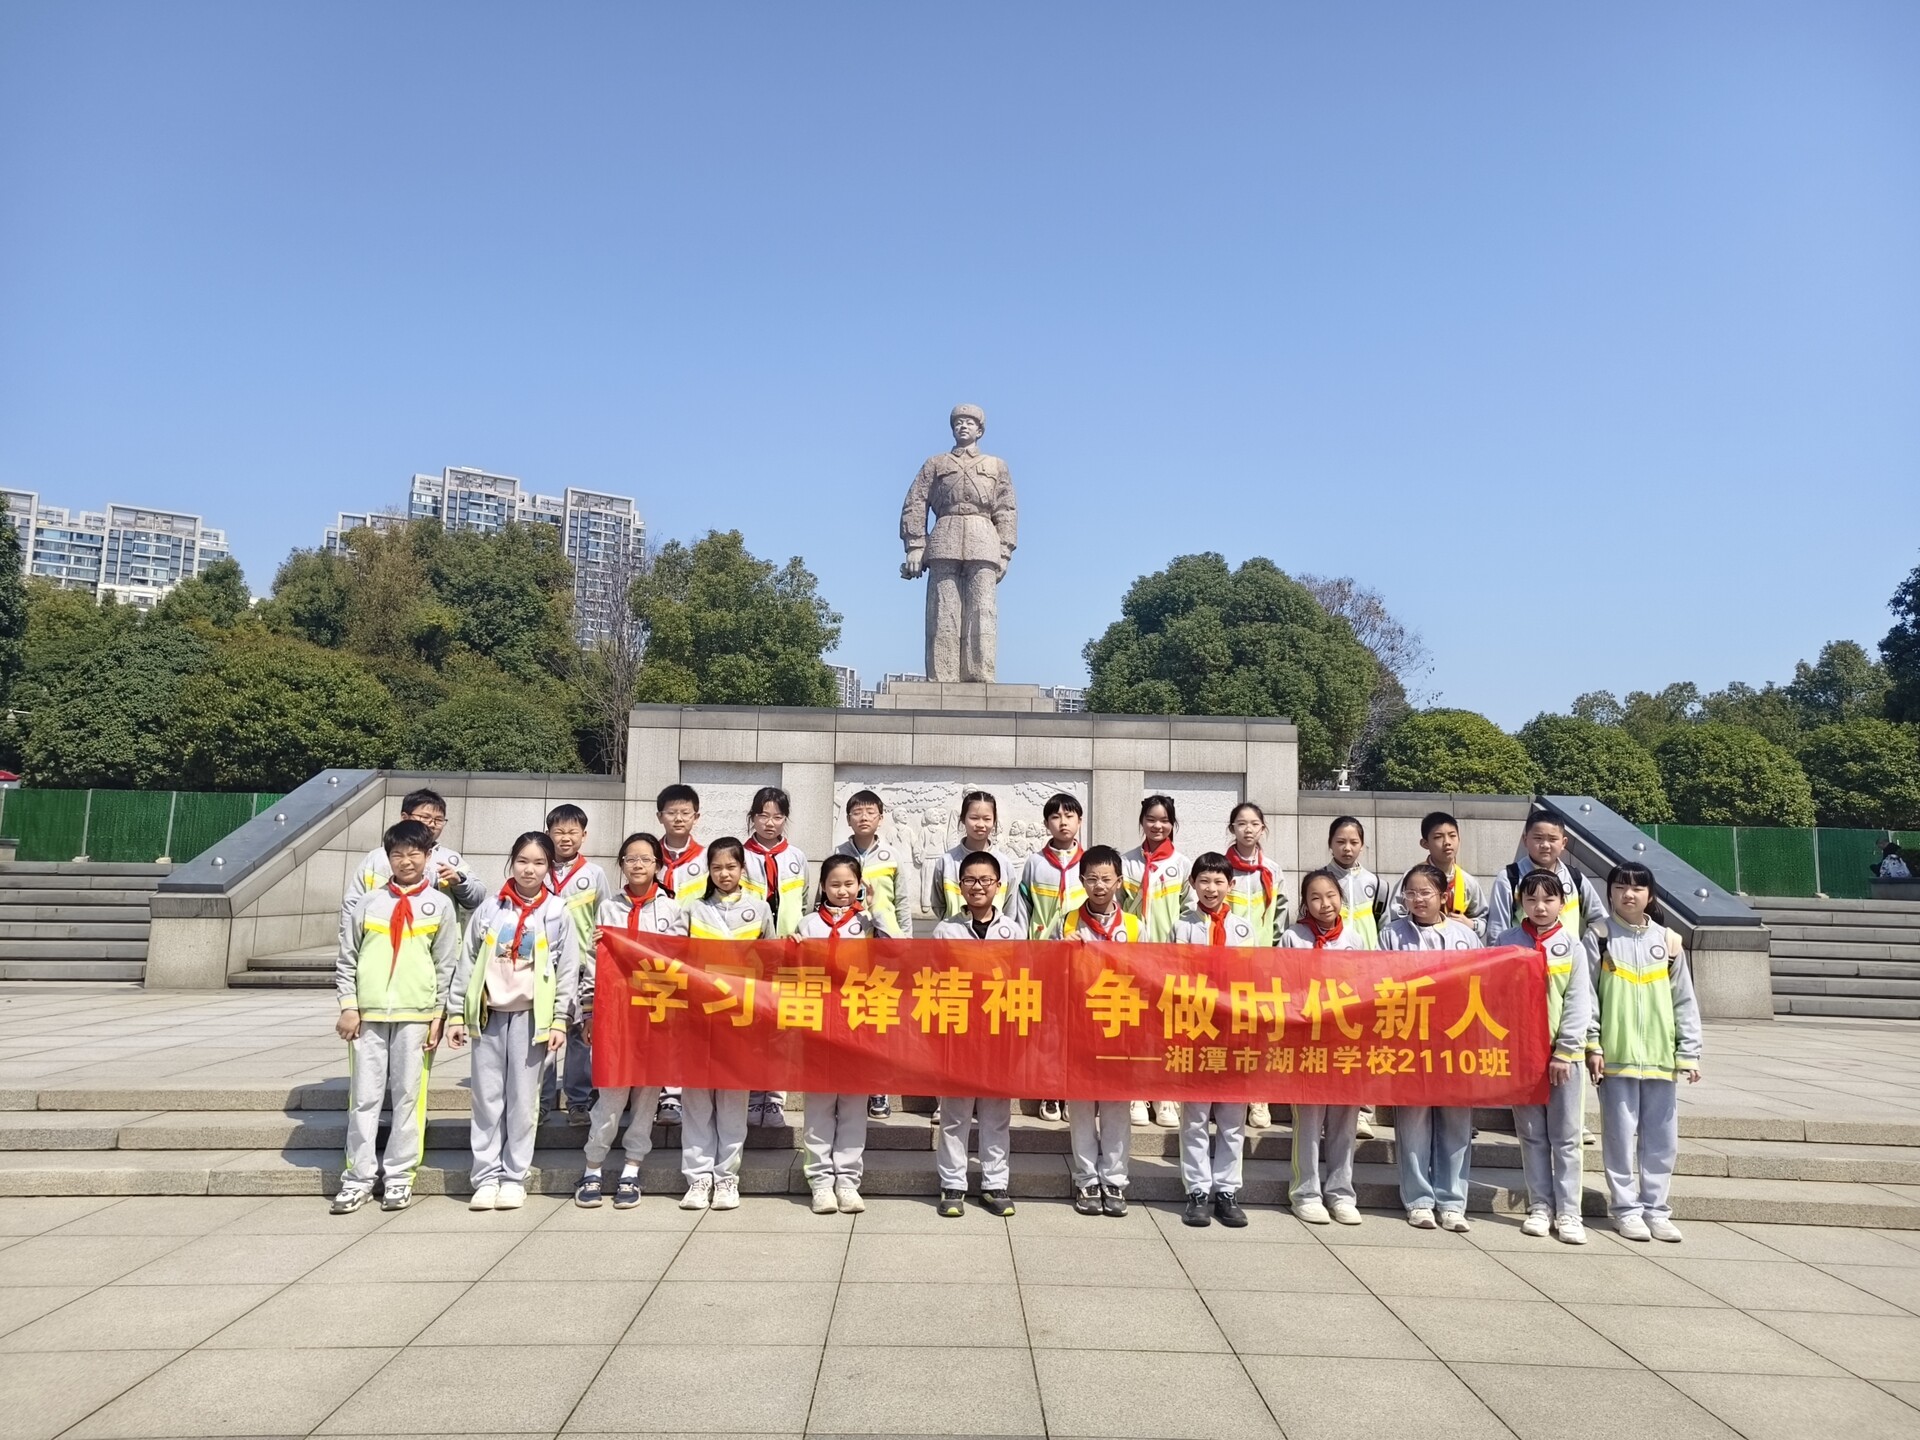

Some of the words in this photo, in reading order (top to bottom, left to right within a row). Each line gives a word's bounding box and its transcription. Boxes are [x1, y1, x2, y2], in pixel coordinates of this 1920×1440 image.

[631, 957, 1043, 1036] 学习雷锋精神
[1085, 968, 1509, 1041] 争做时代新人
